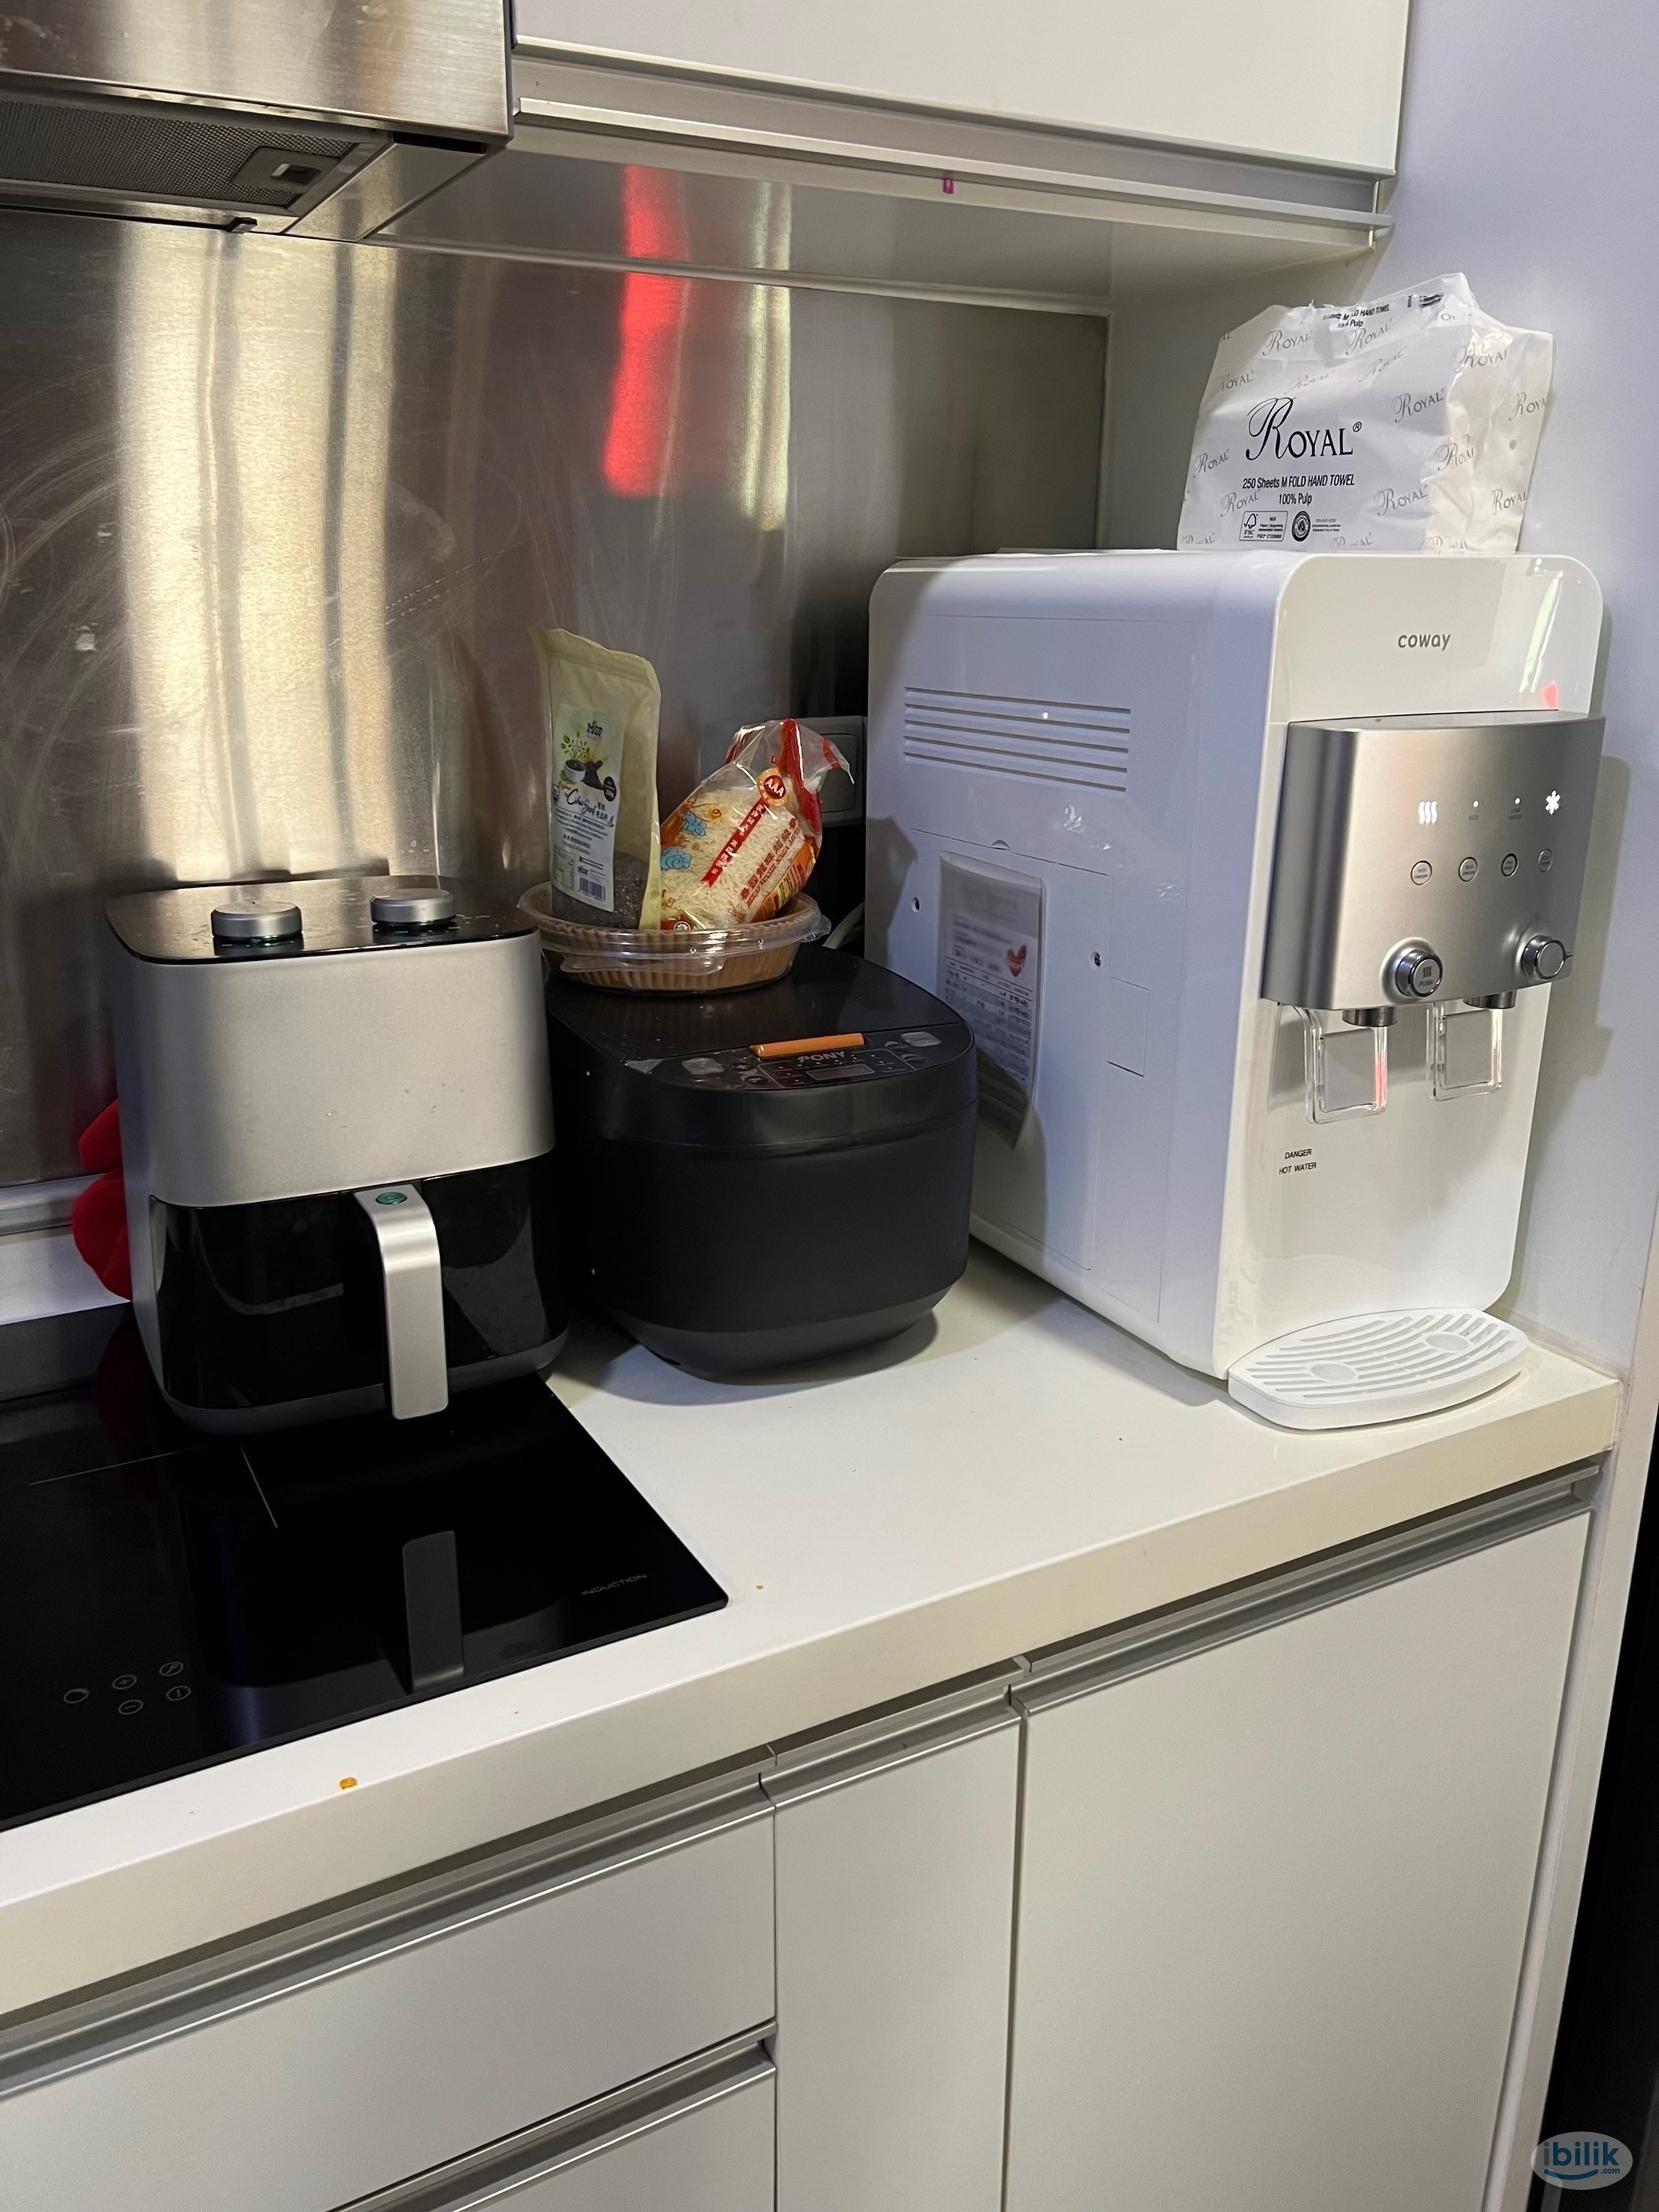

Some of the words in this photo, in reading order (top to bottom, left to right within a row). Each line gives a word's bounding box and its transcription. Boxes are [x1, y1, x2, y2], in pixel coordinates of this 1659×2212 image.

[1262, 329, 1310, 356] ROYAL
[1392, 392, 1444, 423] ROYAL
[1193, 451, 1230, 478] ROYAL
[1242, 478, 1257, 489] 250
[1257, 477, 1280, 488] Sheets
[1280, 476, 1288, 488] M
[1289, 475, 1306, 487] FOLD
[1307, 475, 1328, 487] HAND
[1330, 474, 1355, 485] TOWEL
[1220, 492, 1260, 517] ROYAL
[1279, 493, 1297, 505] 100%
[1298, 492, 1313, 506] Pulp
[1373, 488, 1428, 516] ROYAL
[1398, 634, 1451, 651] coway
[765, 778, 784, 797] AAA
[1284, 1148, 1312, 1160] DANGER
[1279, 1165, 1292, 1174] HOT
[1294, 1161, 1317, 1172] WATER
